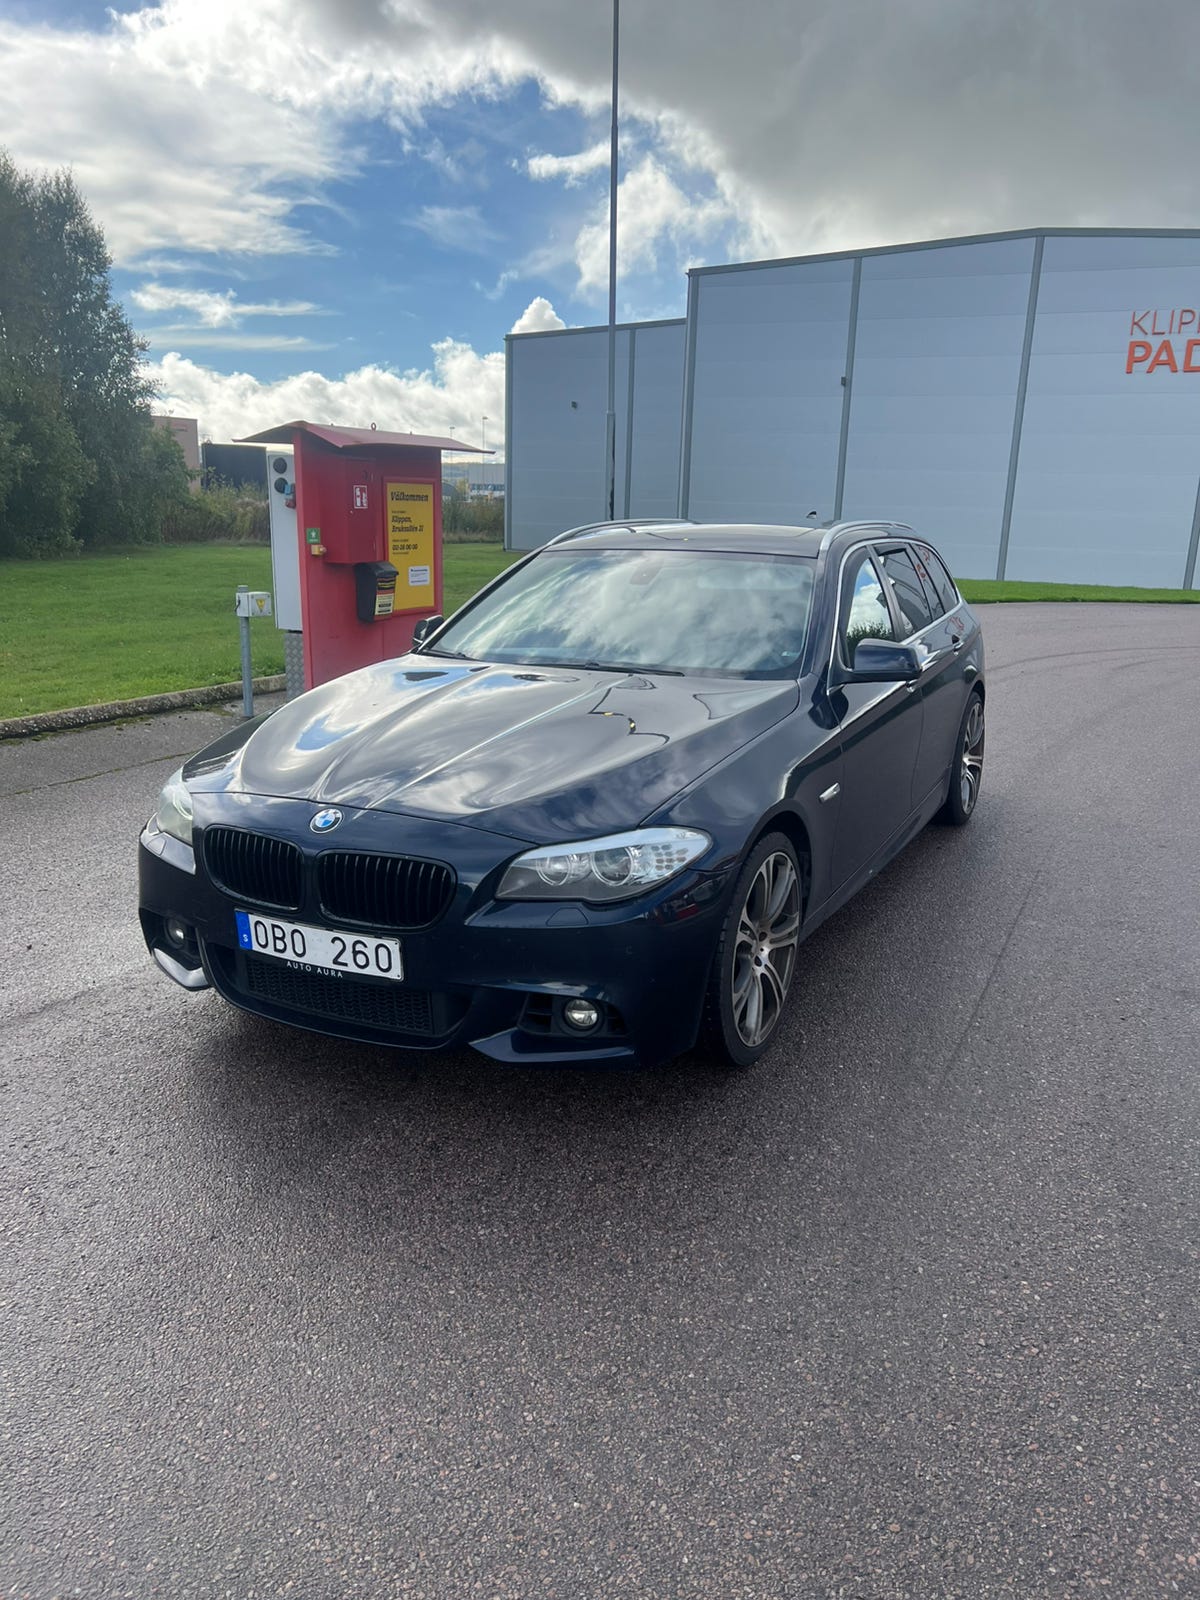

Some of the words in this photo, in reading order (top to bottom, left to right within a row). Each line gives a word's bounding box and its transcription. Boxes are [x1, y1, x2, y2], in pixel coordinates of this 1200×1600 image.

[1130, 308, 1200, 336] KLIP
[391, 490, 428, 501] Välkommen
[330, 936, 392, 973] 260
[286, 960, 312, 973] AUTO
[316, 966, 344, 978] AURA
